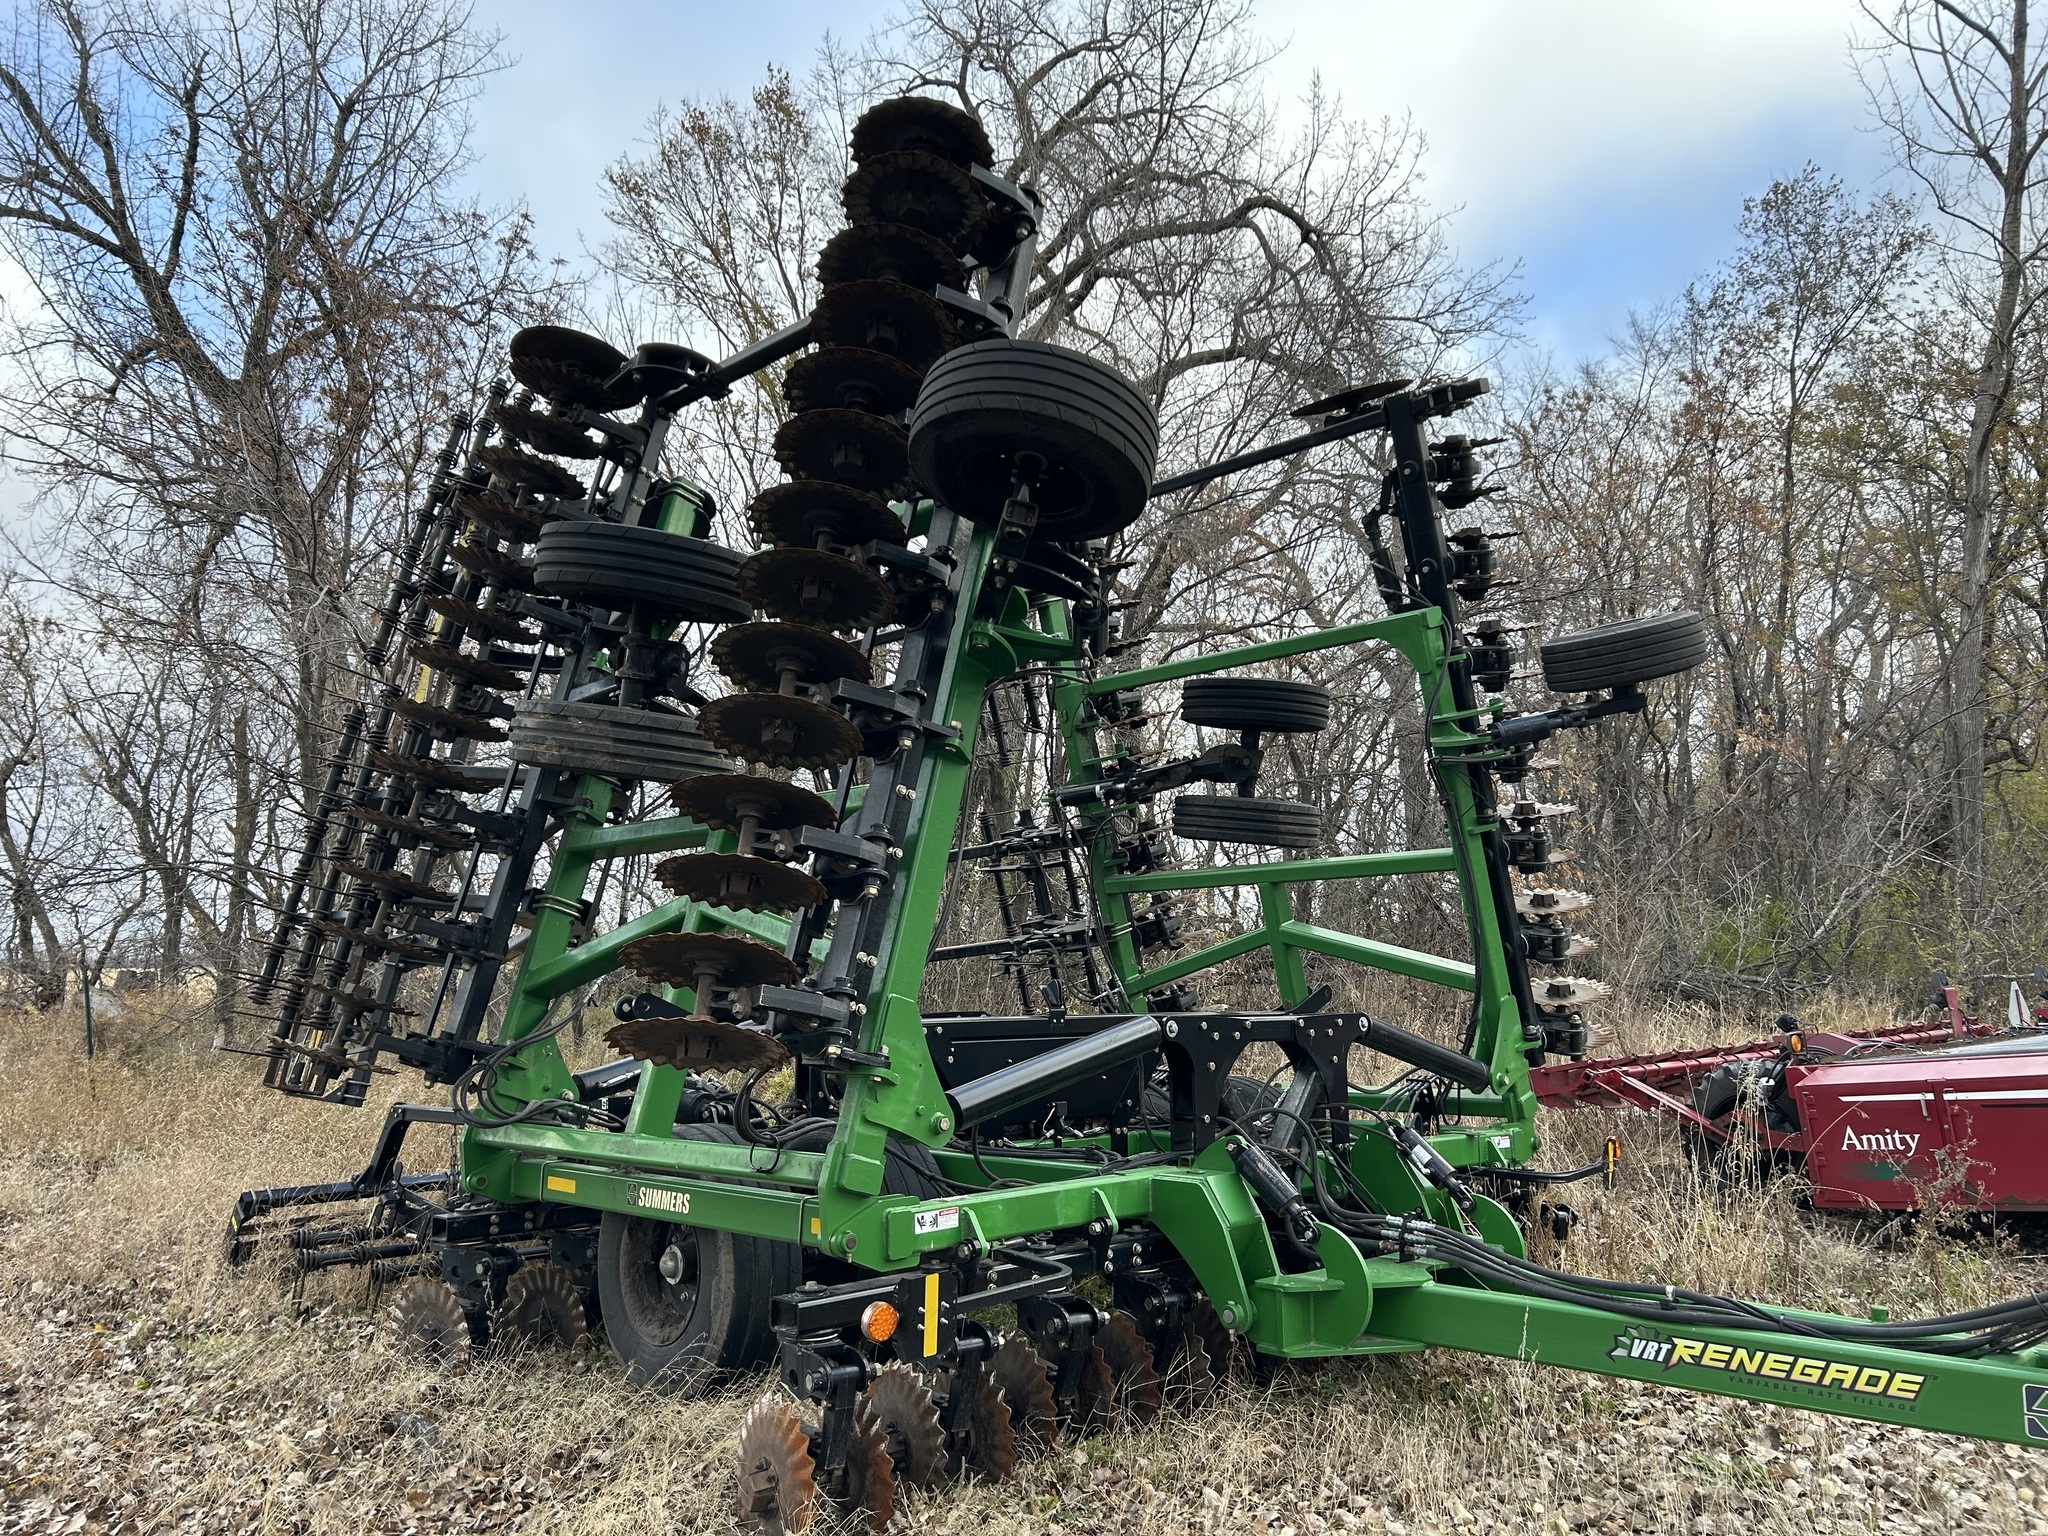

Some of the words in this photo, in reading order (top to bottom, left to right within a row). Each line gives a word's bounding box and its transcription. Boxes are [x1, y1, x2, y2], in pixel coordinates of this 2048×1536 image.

[1841, 1125, 1920, 1157] Amity
[638, 1186, 691, 1215] SUMMERS
[1629, 1338, 1673, 1362] VRT
[1667, 1337, 1926, 1400] RENEGADE
[1729, 1375, 1798, 1393] VARIABLE
[1807, 1388, 1843, 1400] RATE
[1852, 1396, 1917, 1412] TILLAGE
